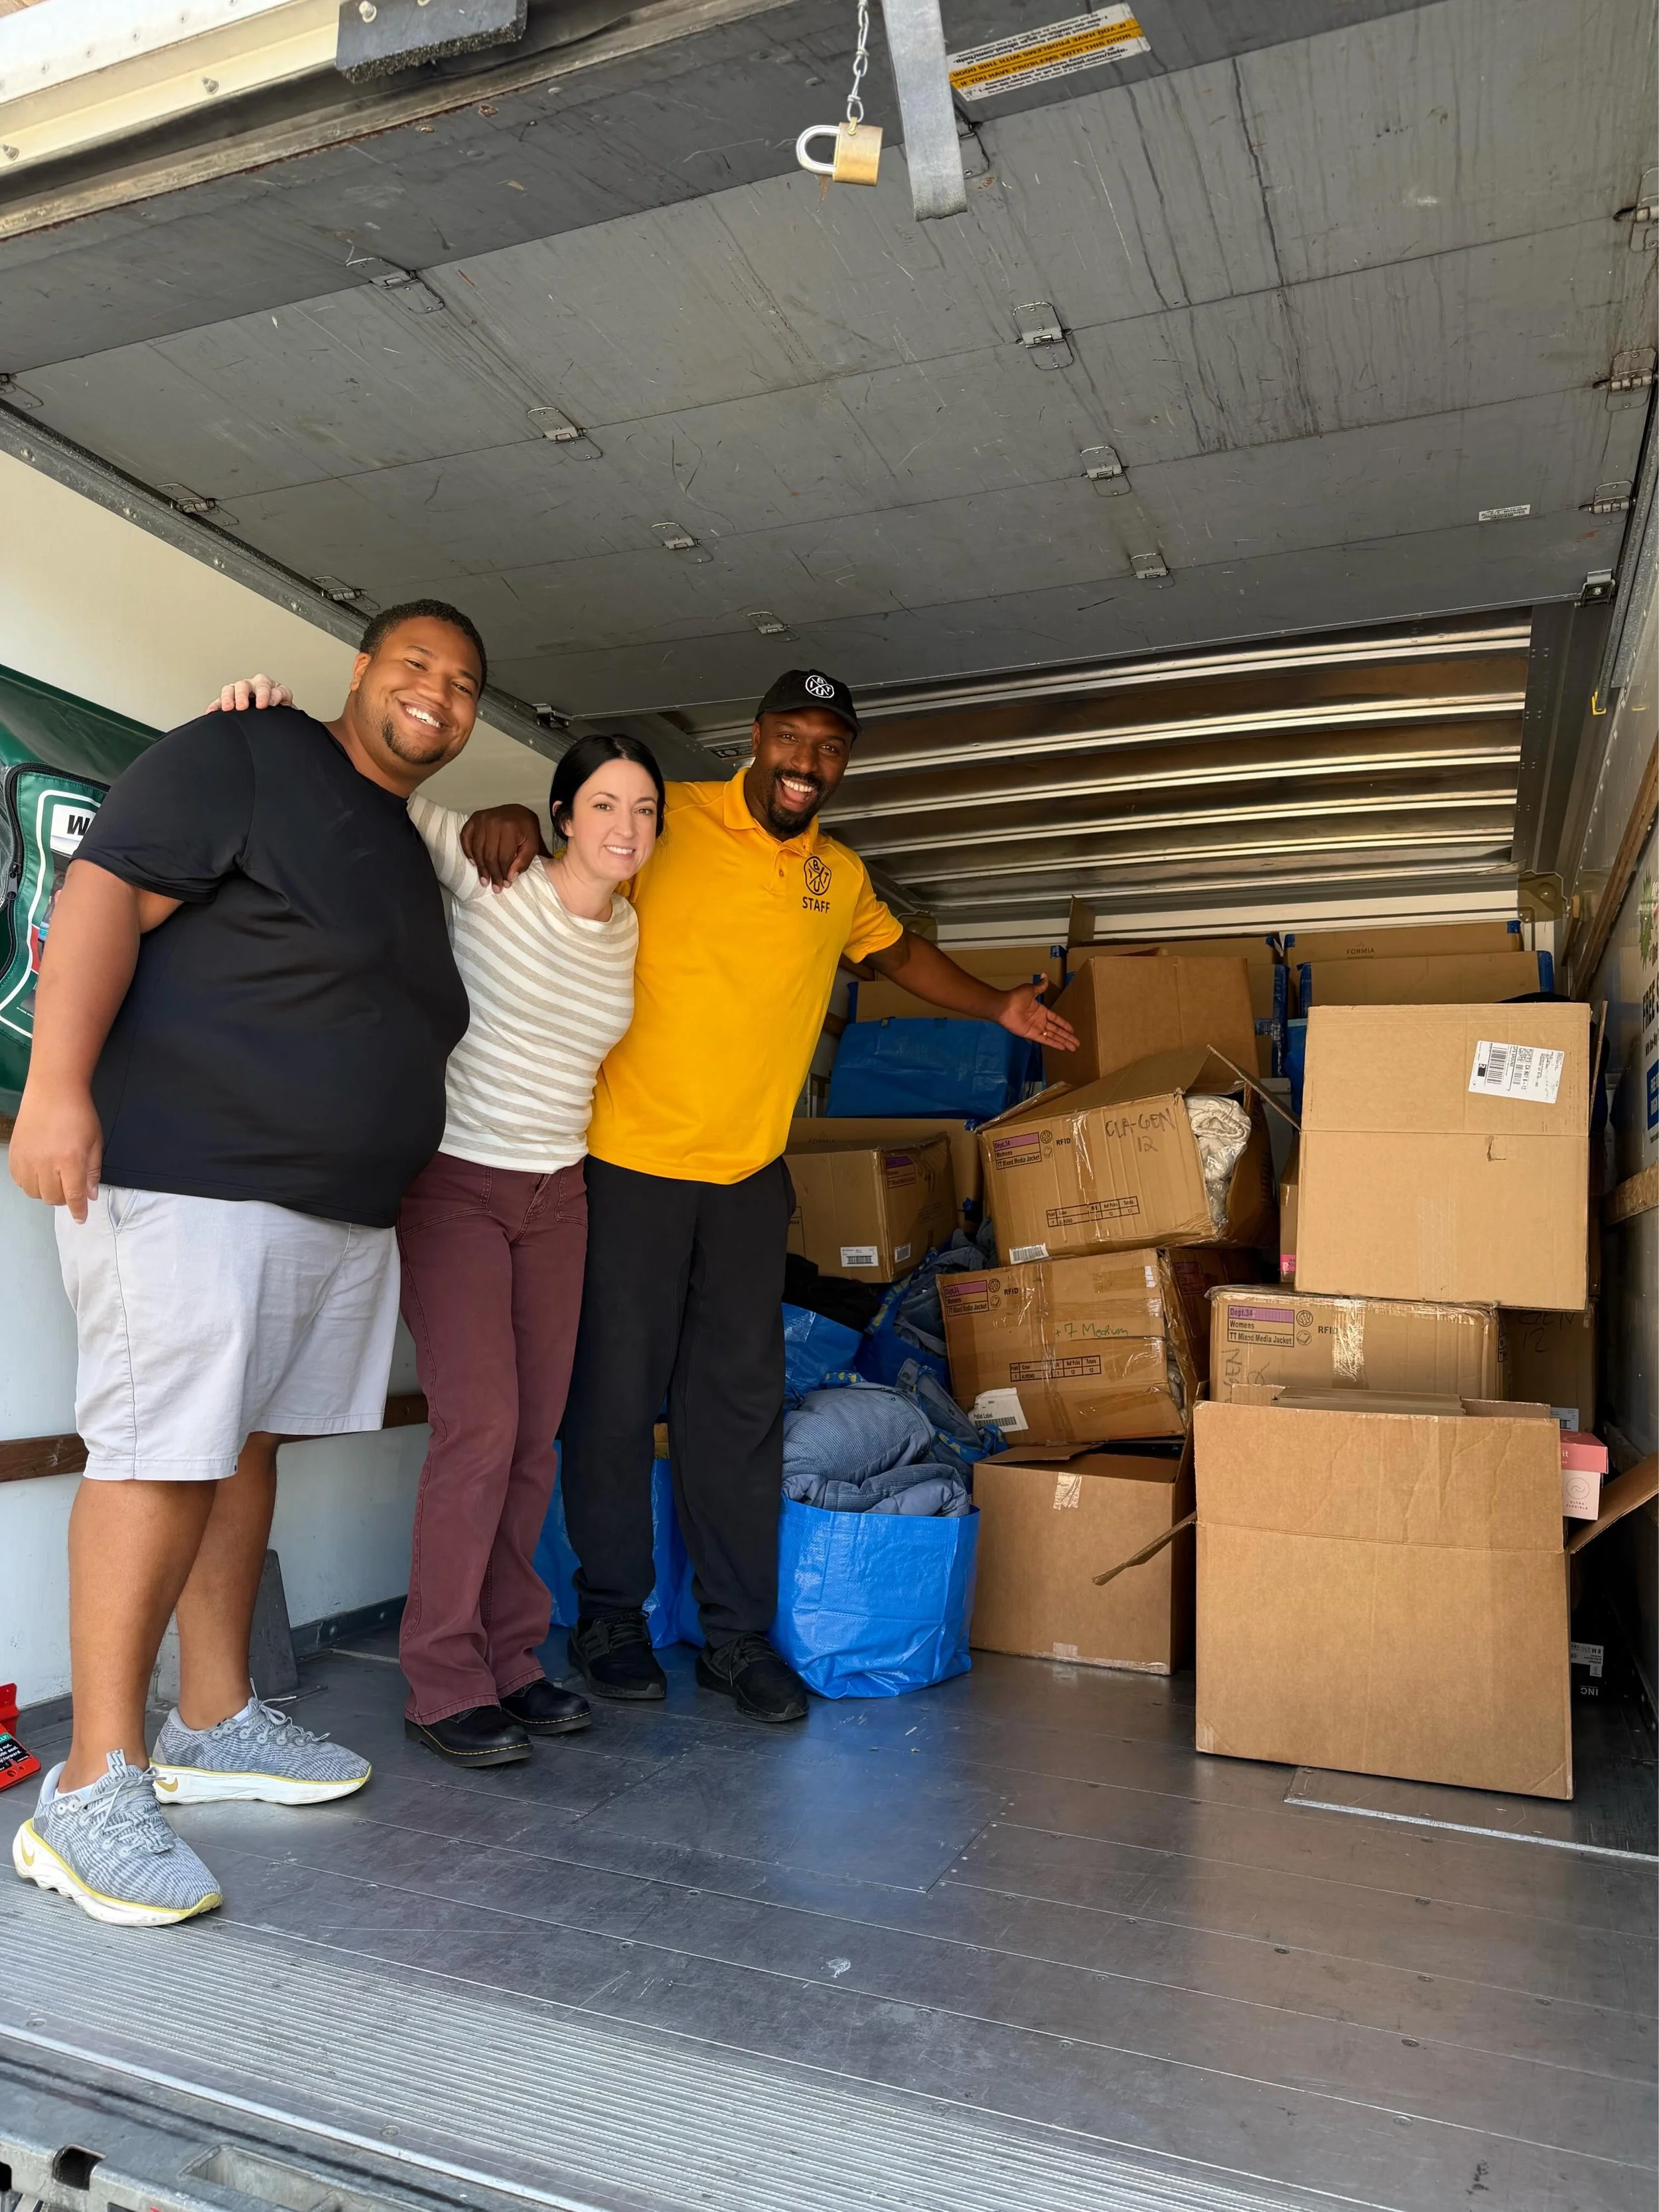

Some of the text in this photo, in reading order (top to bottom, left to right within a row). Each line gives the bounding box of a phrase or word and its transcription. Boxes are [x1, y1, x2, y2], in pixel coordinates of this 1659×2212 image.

[1074, 31, 1096, 42] HAVE
[1023, 40, 1070, 57] PROBLEMS
[989, 69, 1009, 78] HAVE
[1013, 55, 1058, 71] PROBLEMS
[1060, 48, 1083, 58] WITH
[1086, 41, 1105, 50] THIS
[1106, 33, 1131, 43] DOOR
[999, 54, 1022, 64] WITH
[953, 67, 977, 77] DOOR
[802, 897, 830, 913] STAFF
[1137, 1136, 1157, 1152] 12
[1230, 1308, 1253, 1317] Dept.34
[1082, 1323, 1128, 1337] Medium
[1230, 1320, 1254, 1329] Womens
[1238, 1333, 1254, 1341] Mixed
[1256, 1334, 1271, 1343] Media
[1273, 1336, 1292, 1345] Jacket
[1523, 1328, 1551, 1352] 12
[1581, 1687, 1598, 1696] INC
